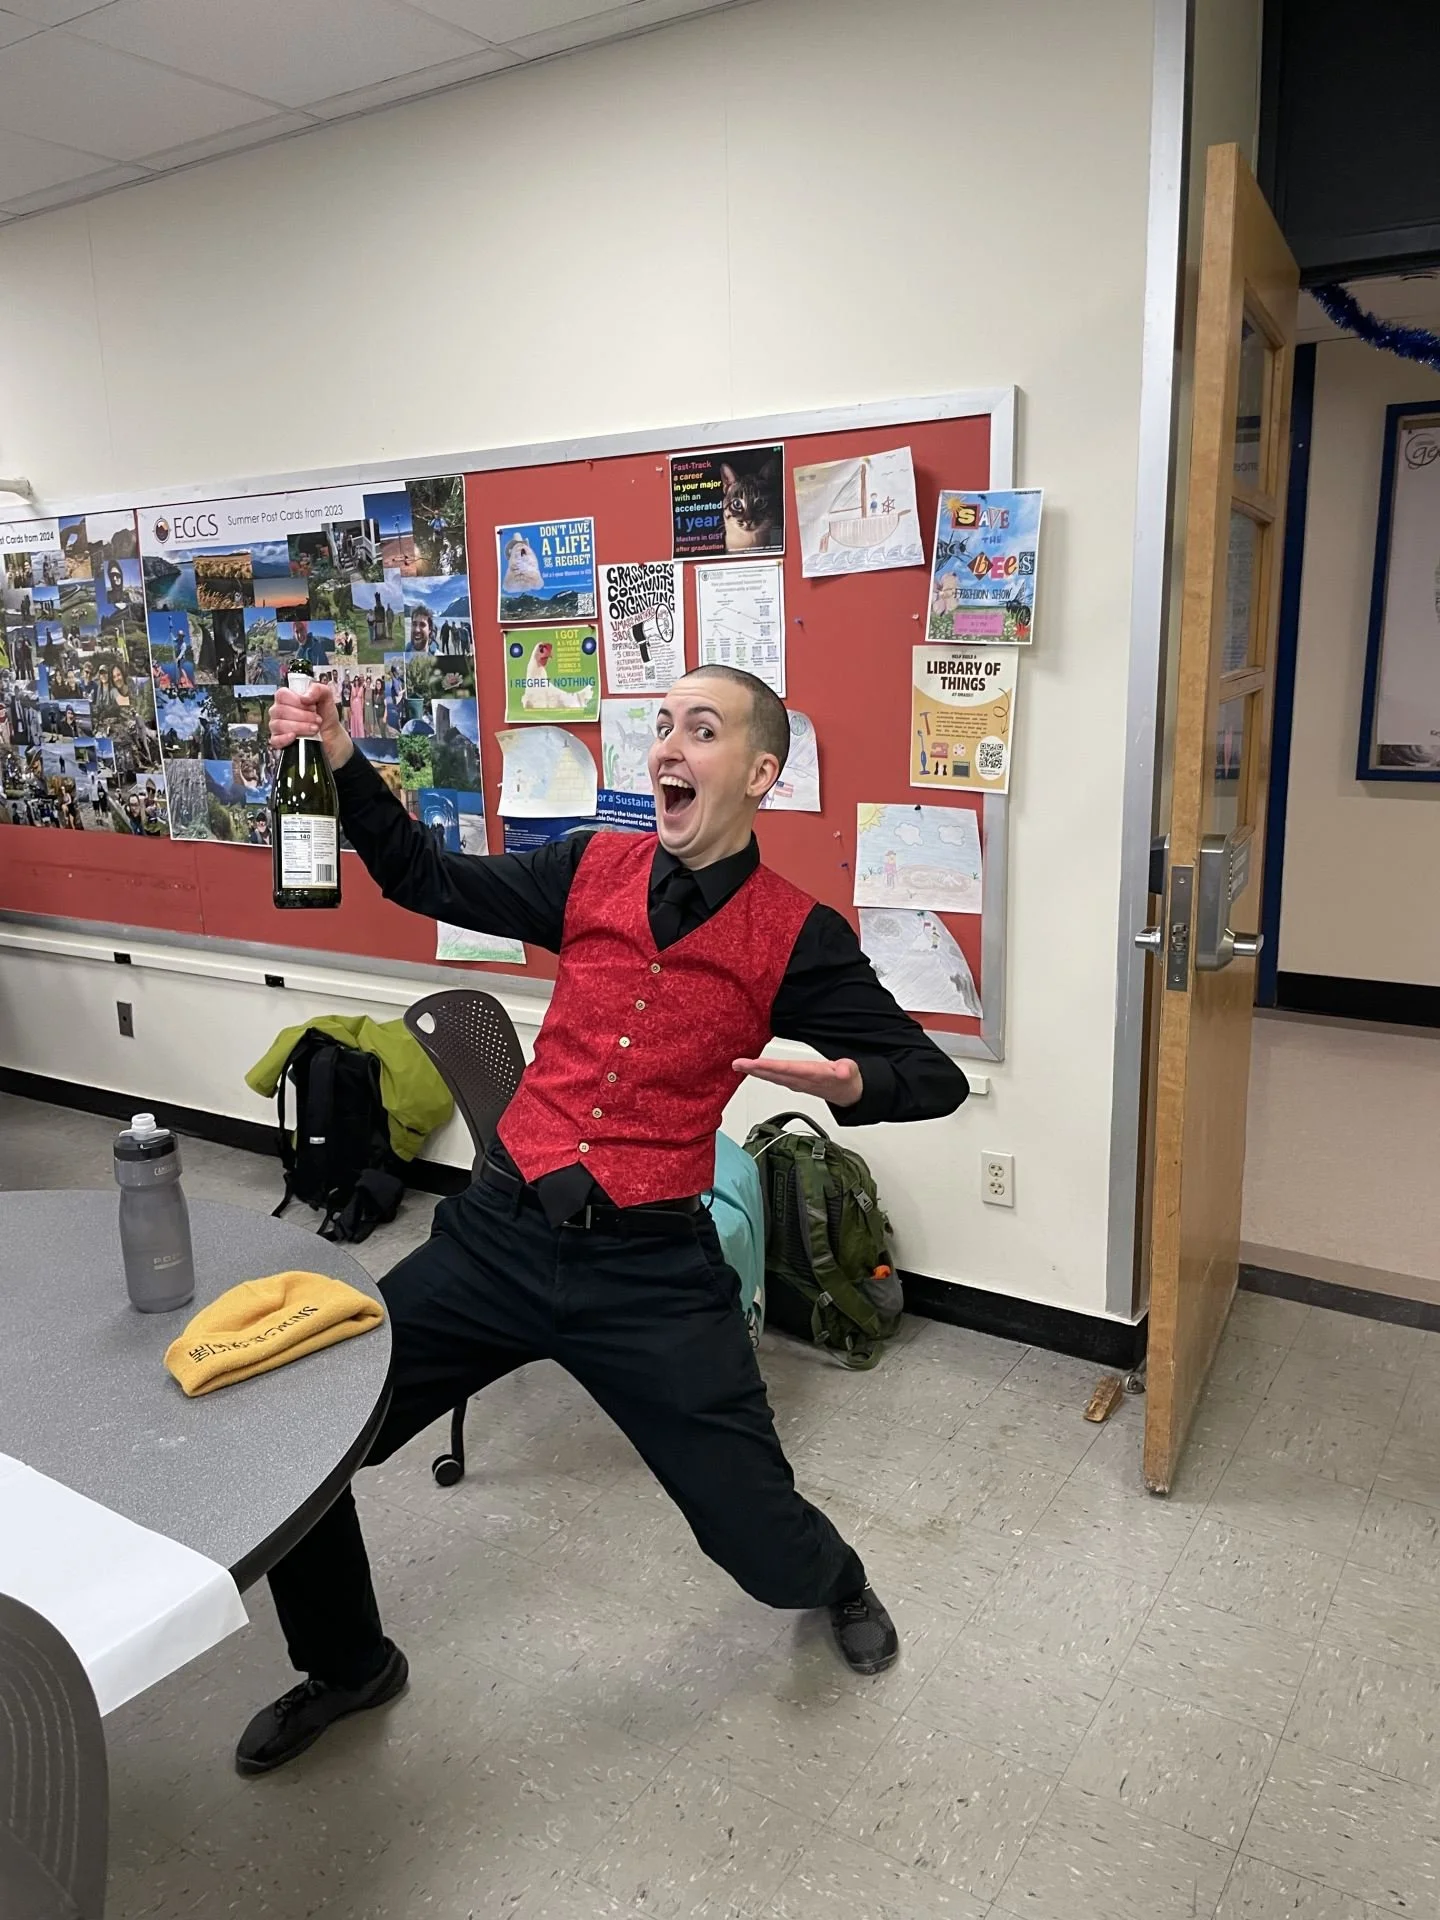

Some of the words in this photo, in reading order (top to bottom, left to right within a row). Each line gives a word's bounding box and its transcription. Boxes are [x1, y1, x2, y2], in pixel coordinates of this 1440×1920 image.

[673, 460, 712, 471] Fast-Track
[680, 472, 704, 481] career
[673, 483, 681, 491] in
[682, 483, 699, 492] your
[700, 480, 722, 490] major
[674, 494, 690, 502] with
[675, 501, 723, 513] accelerated
[173, 514, 219, 539] EGCS
[227, 515, 260, 526] Summer
[261, 511, 278, 522] Post
[280, 509, 304, 521] Cards
[305, 507, 323, 518] from
[324, 504, 344, 517] 2023
[675, 516, 681, 529] 1
[686, 515, 720, 532] year
[954, 505, 1010, 529] SAVE
[540, 524, 567, 537] DON'T
[569, 522, 590, 535] LIVE
[5, 534, 24, 545] Cards
[24, 533, 39, 543] from
[39, 531, 55, 542] 2024
[675, 535, 700, 543] Masters
[982, 536, 1002, 544] THE
[542, 538, 552, 556] A
[555, 535, 590, 555] LIFE
[690, 543, 724, 553] graduation
[555, 553, 591, 567] REGRET
[607, 563, 674, 588] GRASSROOTS
[608, 575, 675, 602] COMMUNITY
[953, 588, 989, 600] FASHION
[992, 588, 1013, 600] SHOW
[609, 591, 675, 619] ORGANIZING
[560, 629, 579, 640] GOT
[926, 660, 982, 676] LIBRARY
[984, 662, 1001, 676] OF
[515, 678, 550, 688] REGRET
[554, 676, 596, 687] NOTHING
[940, 676, 986, 691] THINGS
[597, 794, 607, 802] or
[608, 795, 614, 803] a
[615, 794, 656, 809] Sustaina
[606, 815, 639, 825] Development
[626, 811, 643, 819] United
